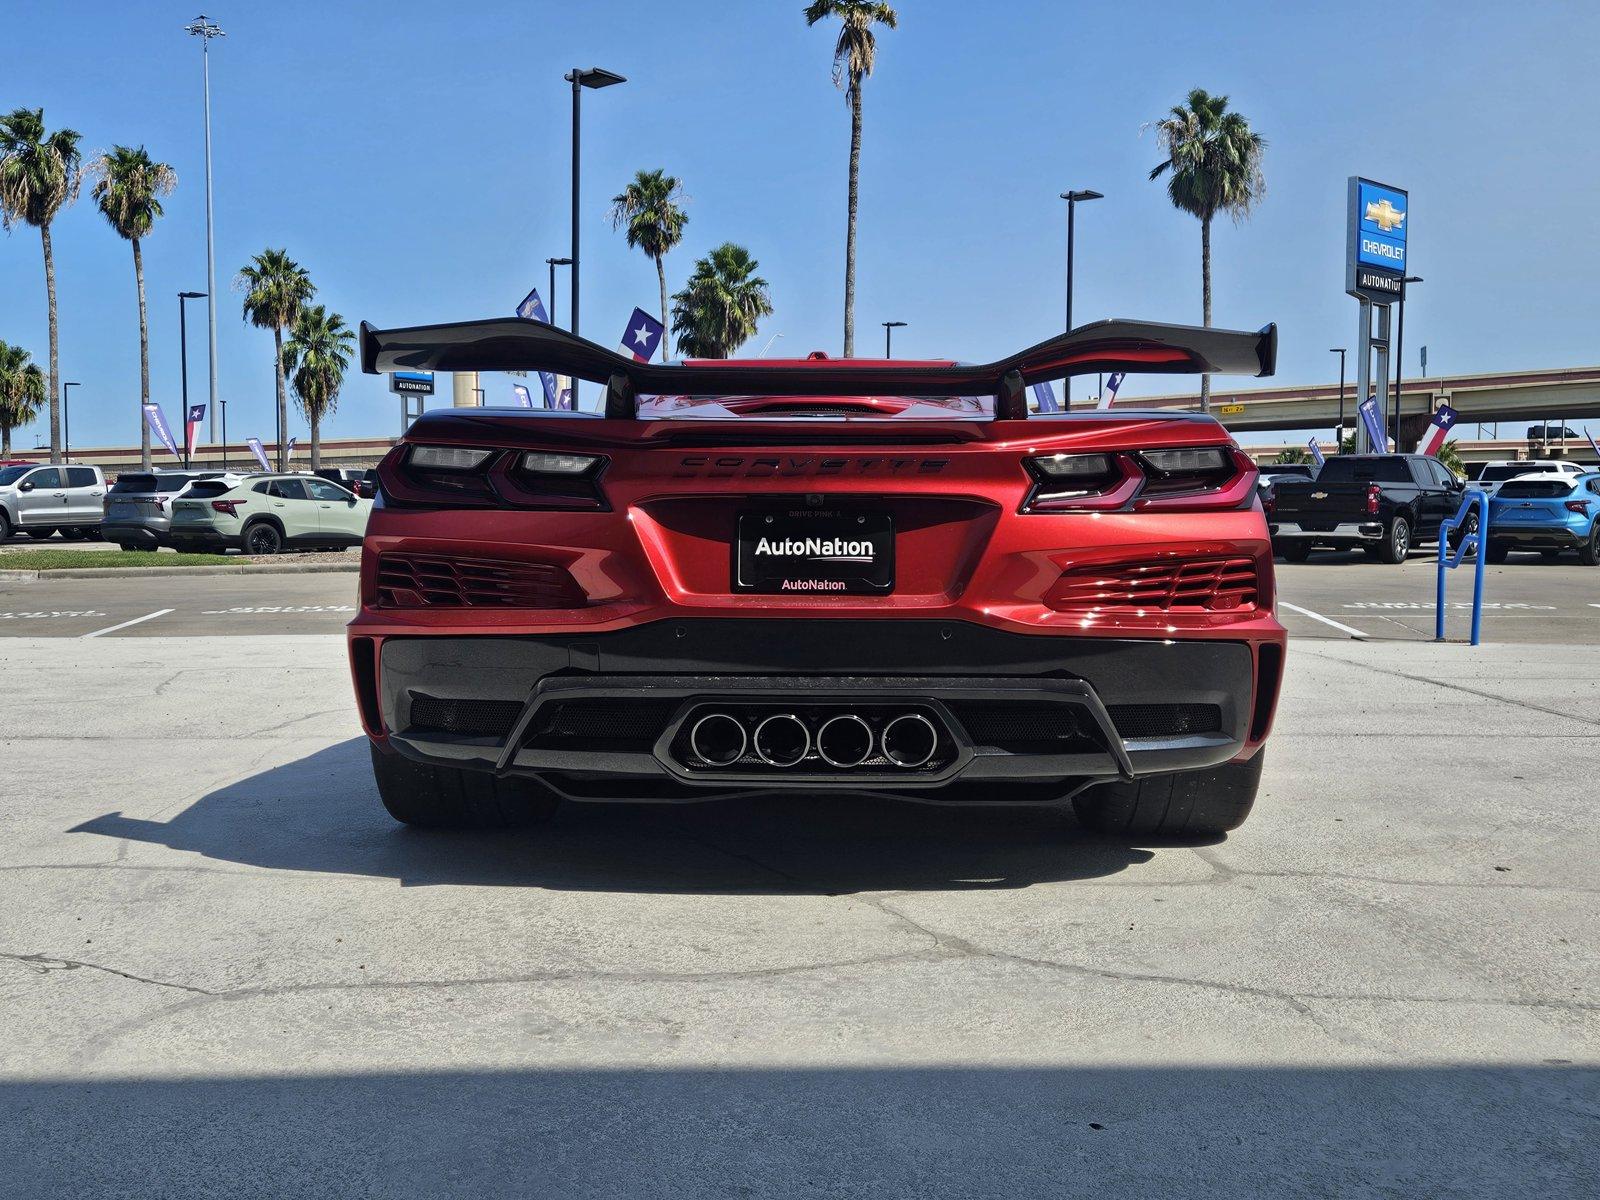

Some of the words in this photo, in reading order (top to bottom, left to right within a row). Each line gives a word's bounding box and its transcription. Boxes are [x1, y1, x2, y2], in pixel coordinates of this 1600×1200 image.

[1363, 240, 1404, 260] CHEVROLET
[399, 382, 431, 391] AUTONATION
[674, 457, 950, 477] CORVETTE
[755, 537, 874, 556] AutoNation
[782, 579, 846, 590] AutoNation
